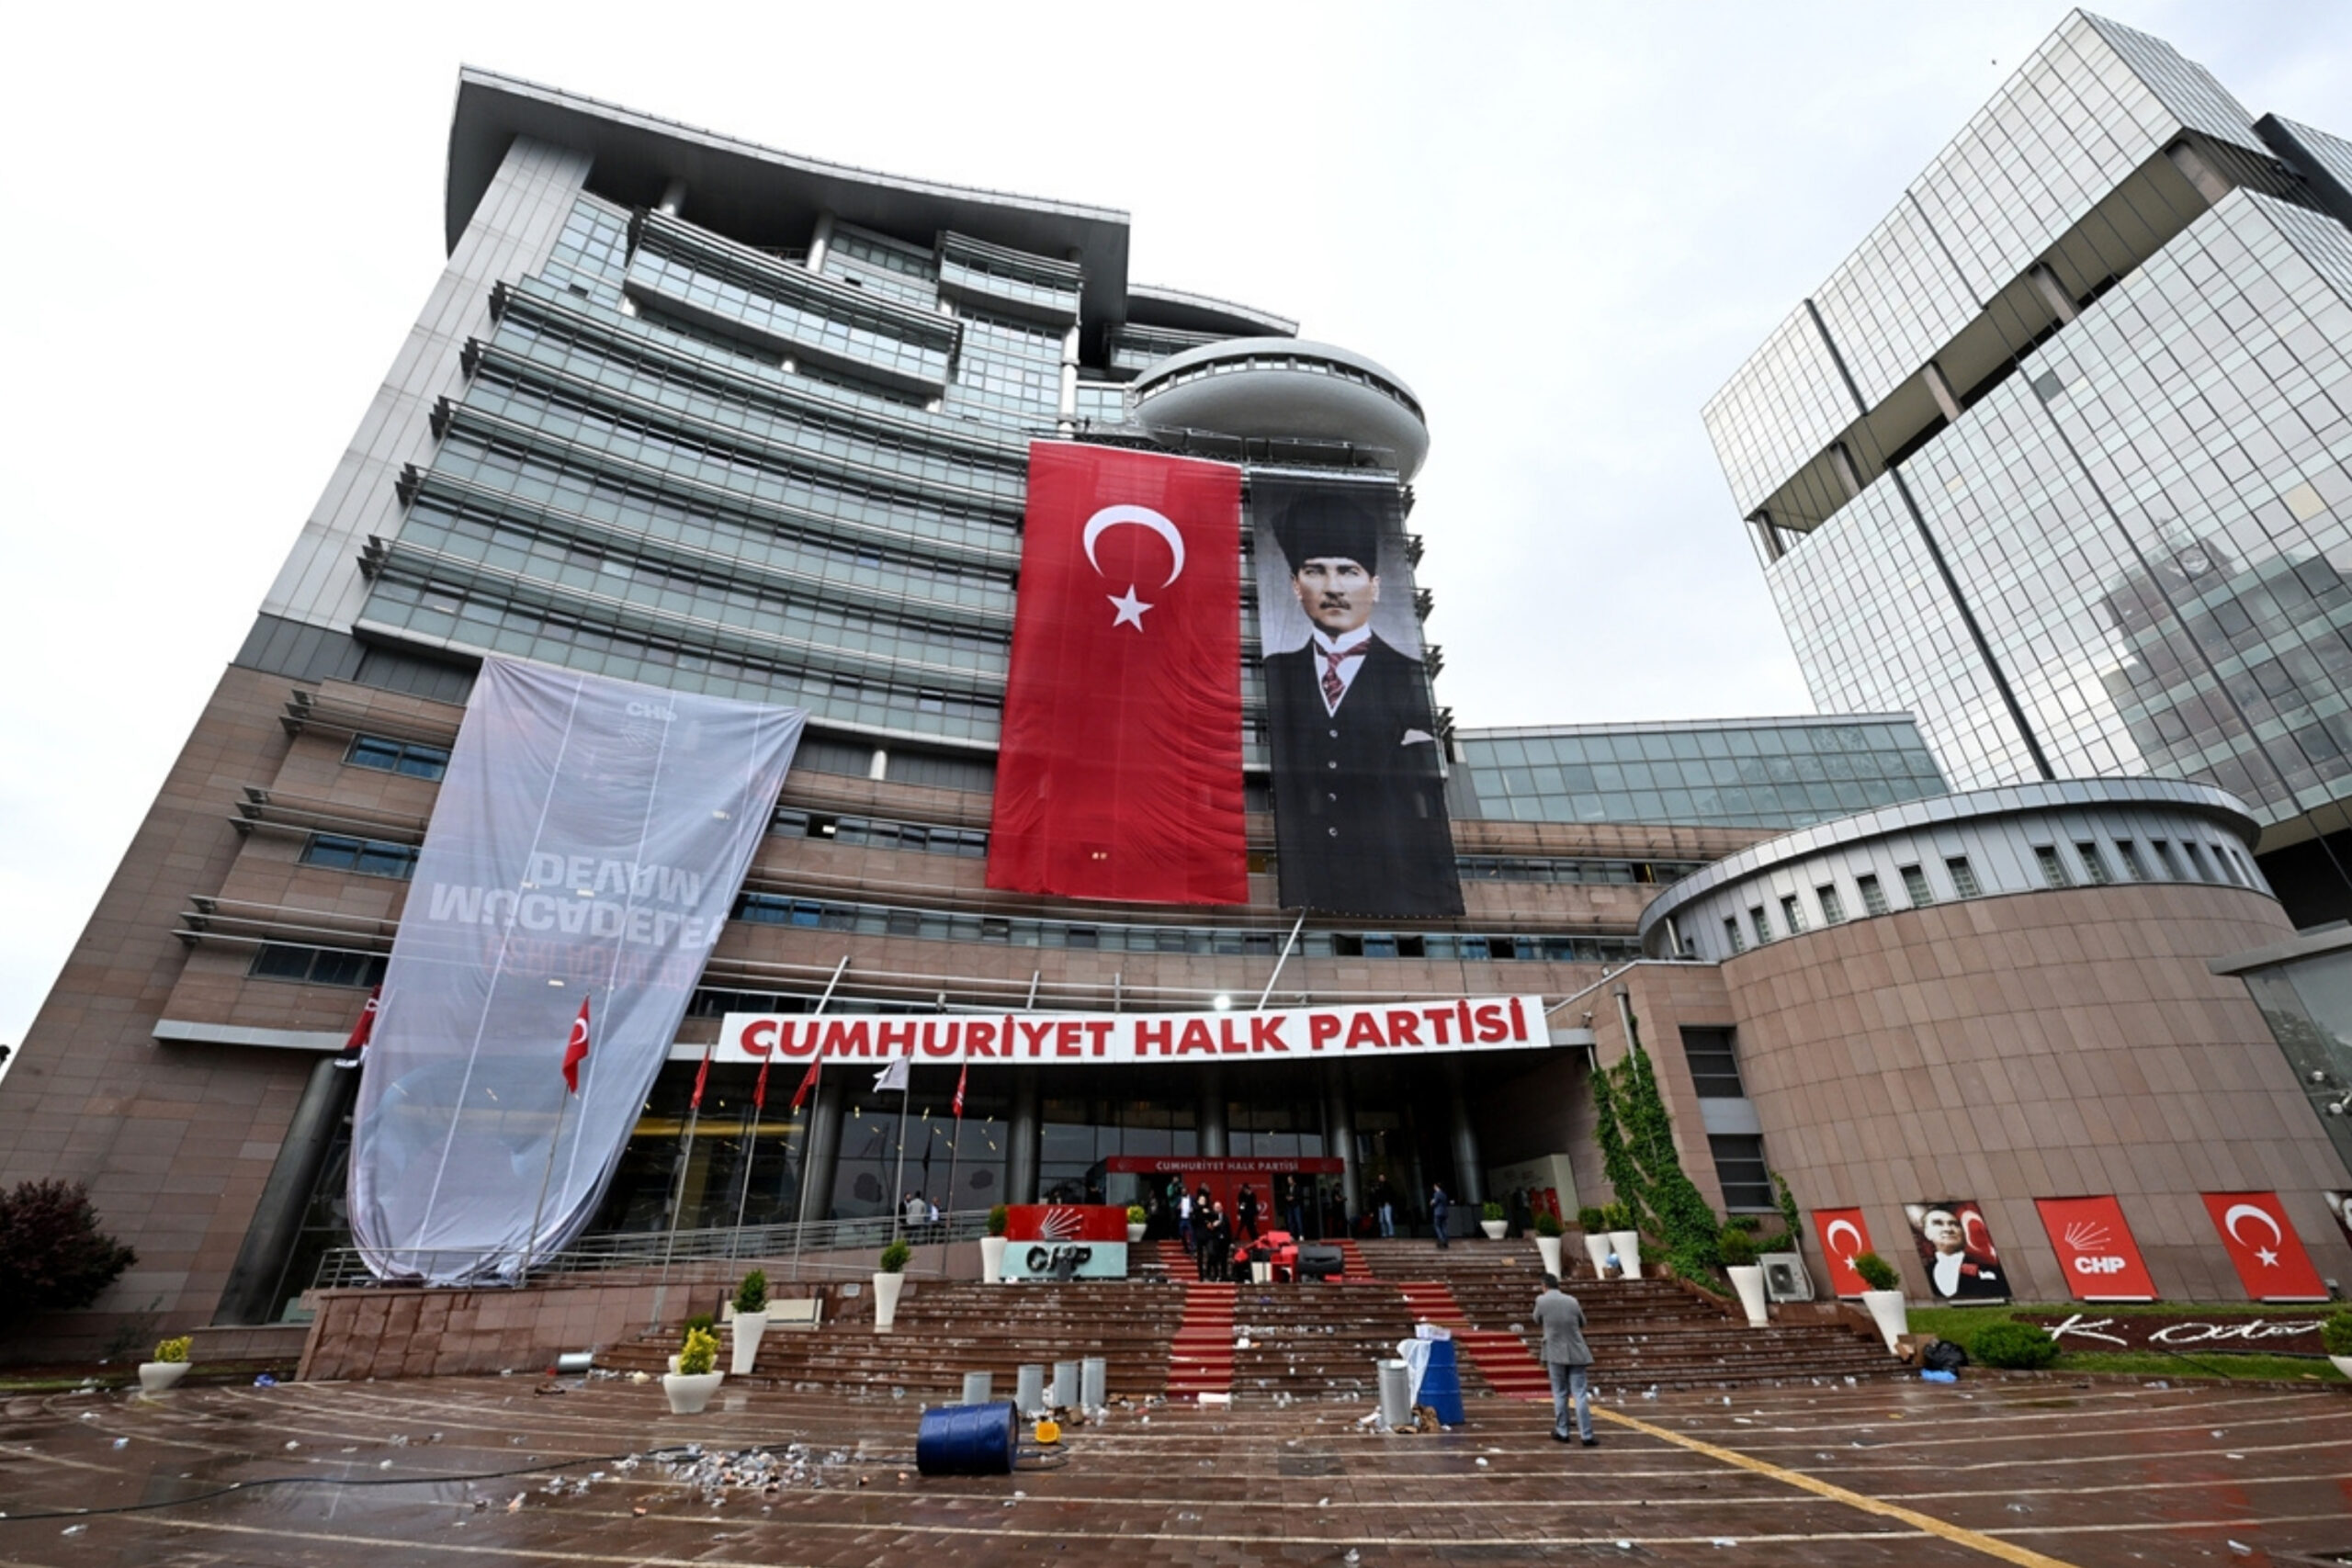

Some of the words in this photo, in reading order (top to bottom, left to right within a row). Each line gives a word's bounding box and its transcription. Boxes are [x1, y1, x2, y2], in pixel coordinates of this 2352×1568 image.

[740, 1014, 1114, 1057] CUMHURİYET
[1134, 1016, 1290, 1055] HALK
[1308, 997, 1528, 1050] PARTİSİ
[1155, 1158, 1226, 1171] CUMHURİYET
[1227, 1159, 1256, 1171] HALK
[1258, 1158, 1299, 1171] PARTİSİ
[1026, 1245, 1092, 1272] CHP
[2074, 1255, 2126, 1274] CHP
